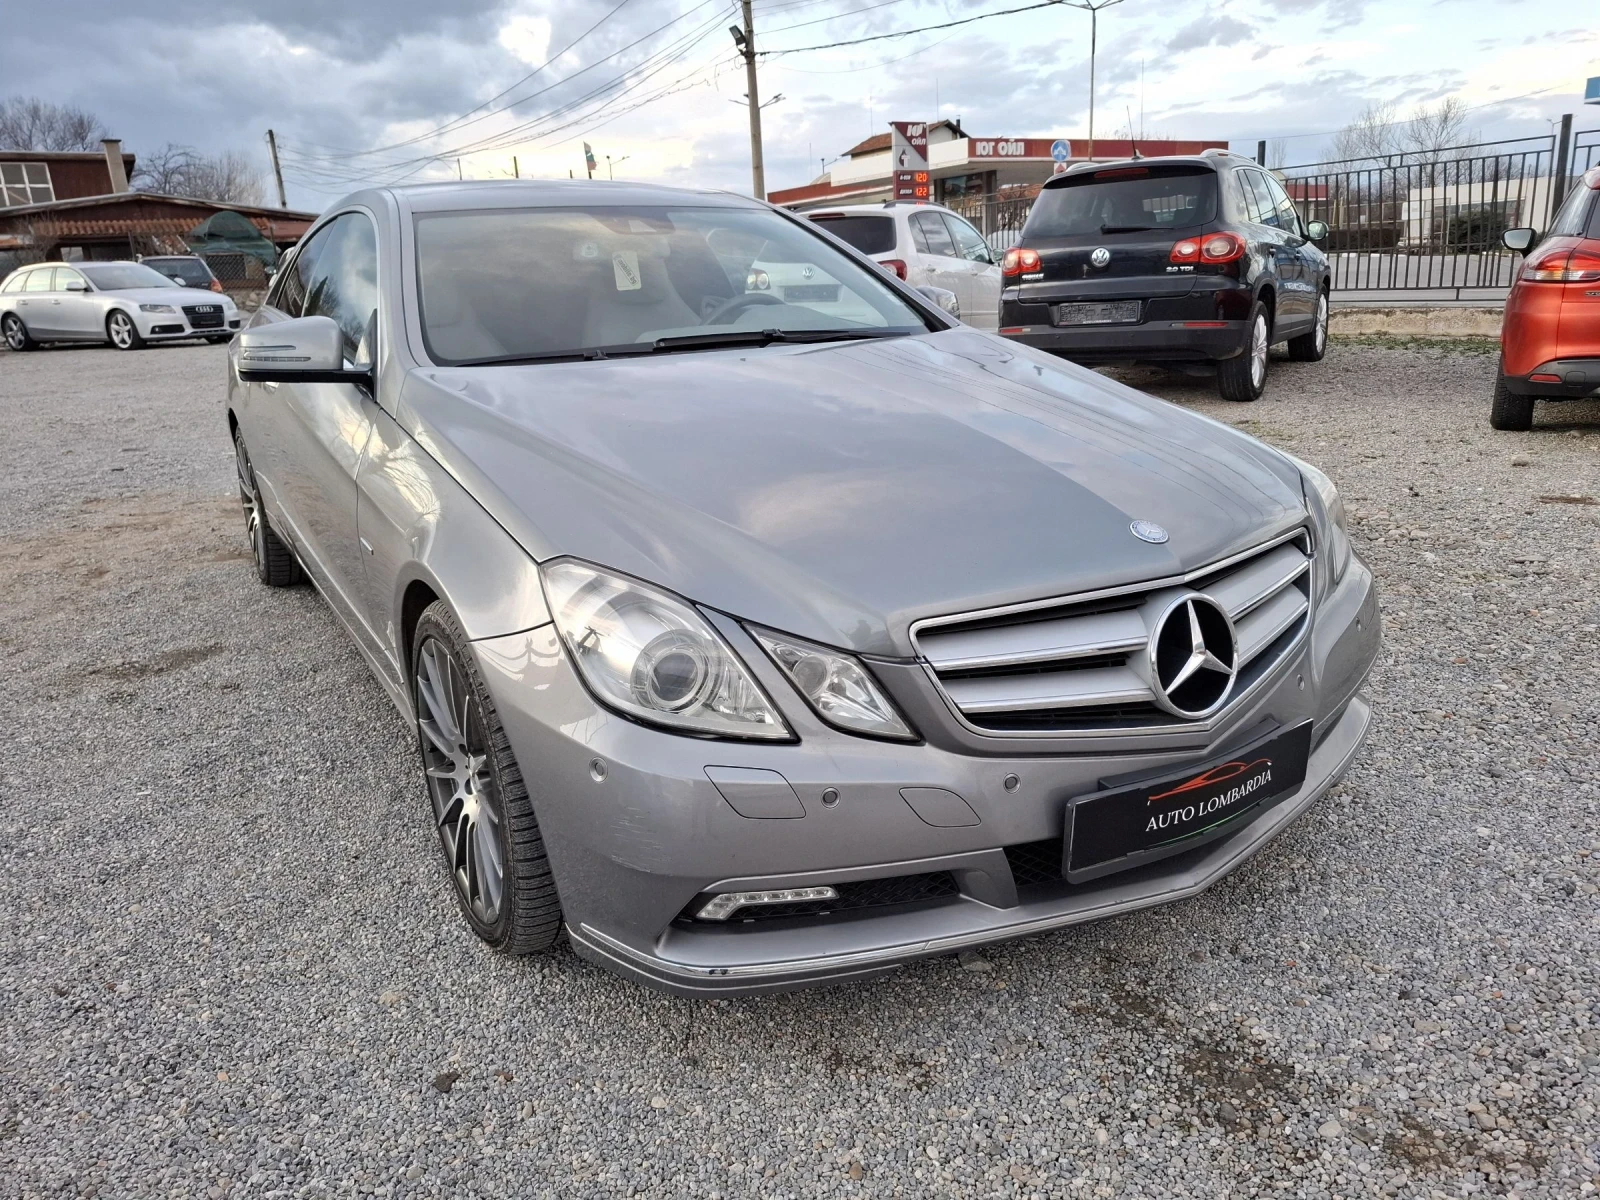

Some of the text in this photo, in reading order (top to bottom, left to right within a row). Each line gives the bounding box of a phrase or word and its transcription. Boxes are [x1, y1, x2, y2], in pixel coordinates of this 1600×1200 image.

[975, 138, 1025, 156] ЮГ ОЙЛ
[1145, 769, 1272, 832] AUTO LOMBARDIA
